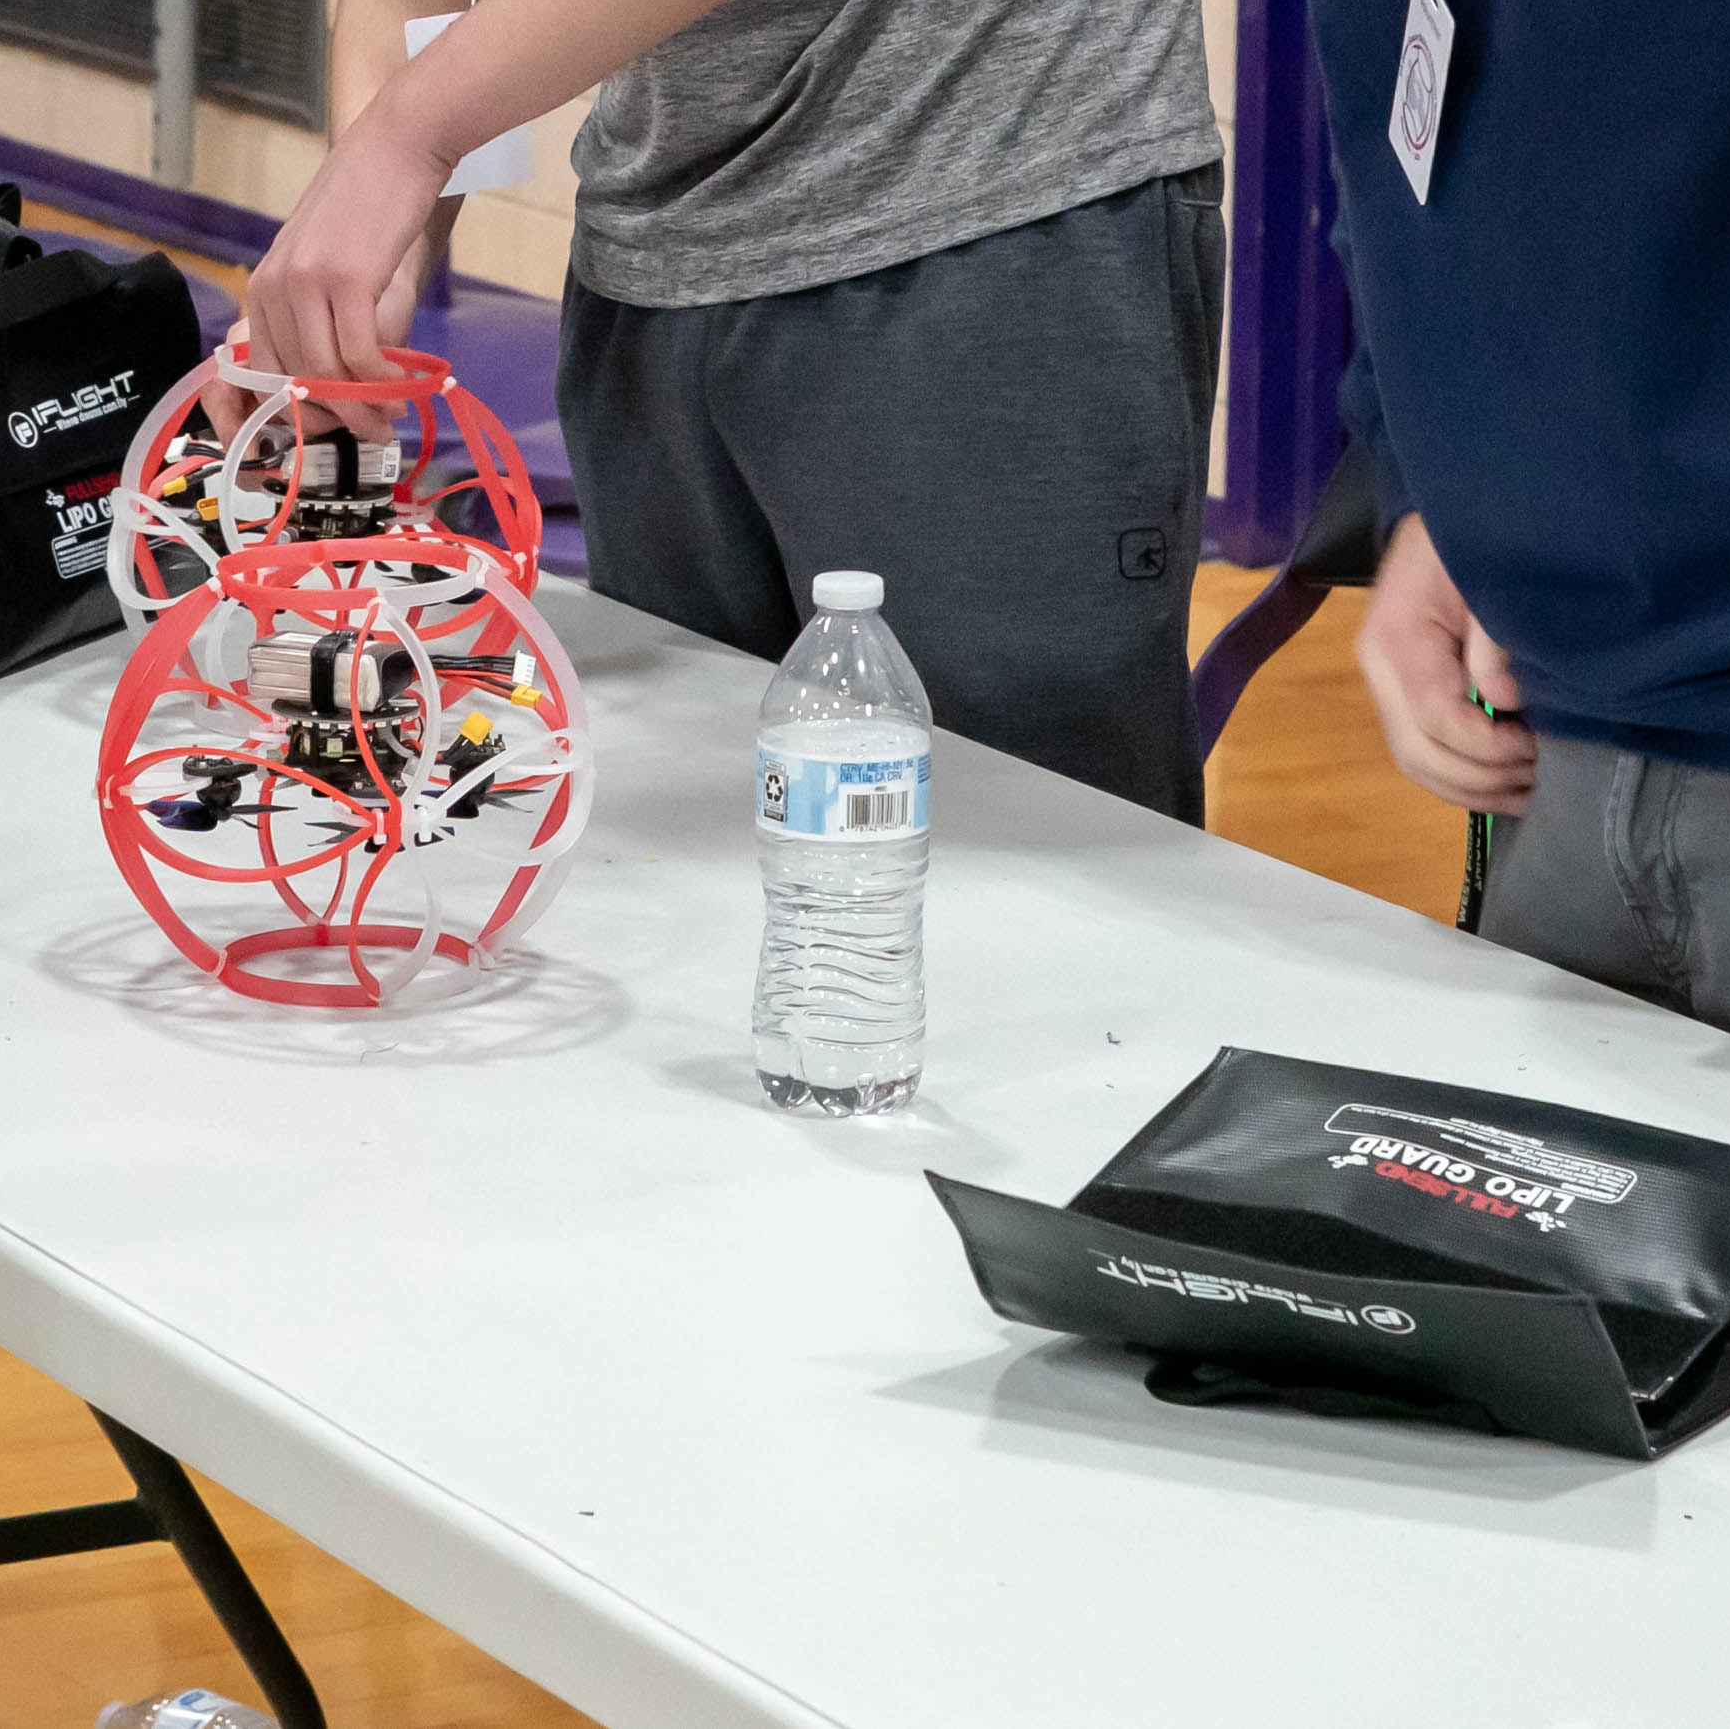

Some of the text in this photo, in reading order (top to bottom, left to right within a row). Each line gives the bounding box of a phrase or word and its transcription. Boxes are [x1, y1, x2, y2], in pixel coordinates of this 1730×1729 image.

[56, 502, 98, 534] LIPO
[1349, 1136, 1476, 1184] GUARD
[1484, 1175, 1575, 1214] LIPO
